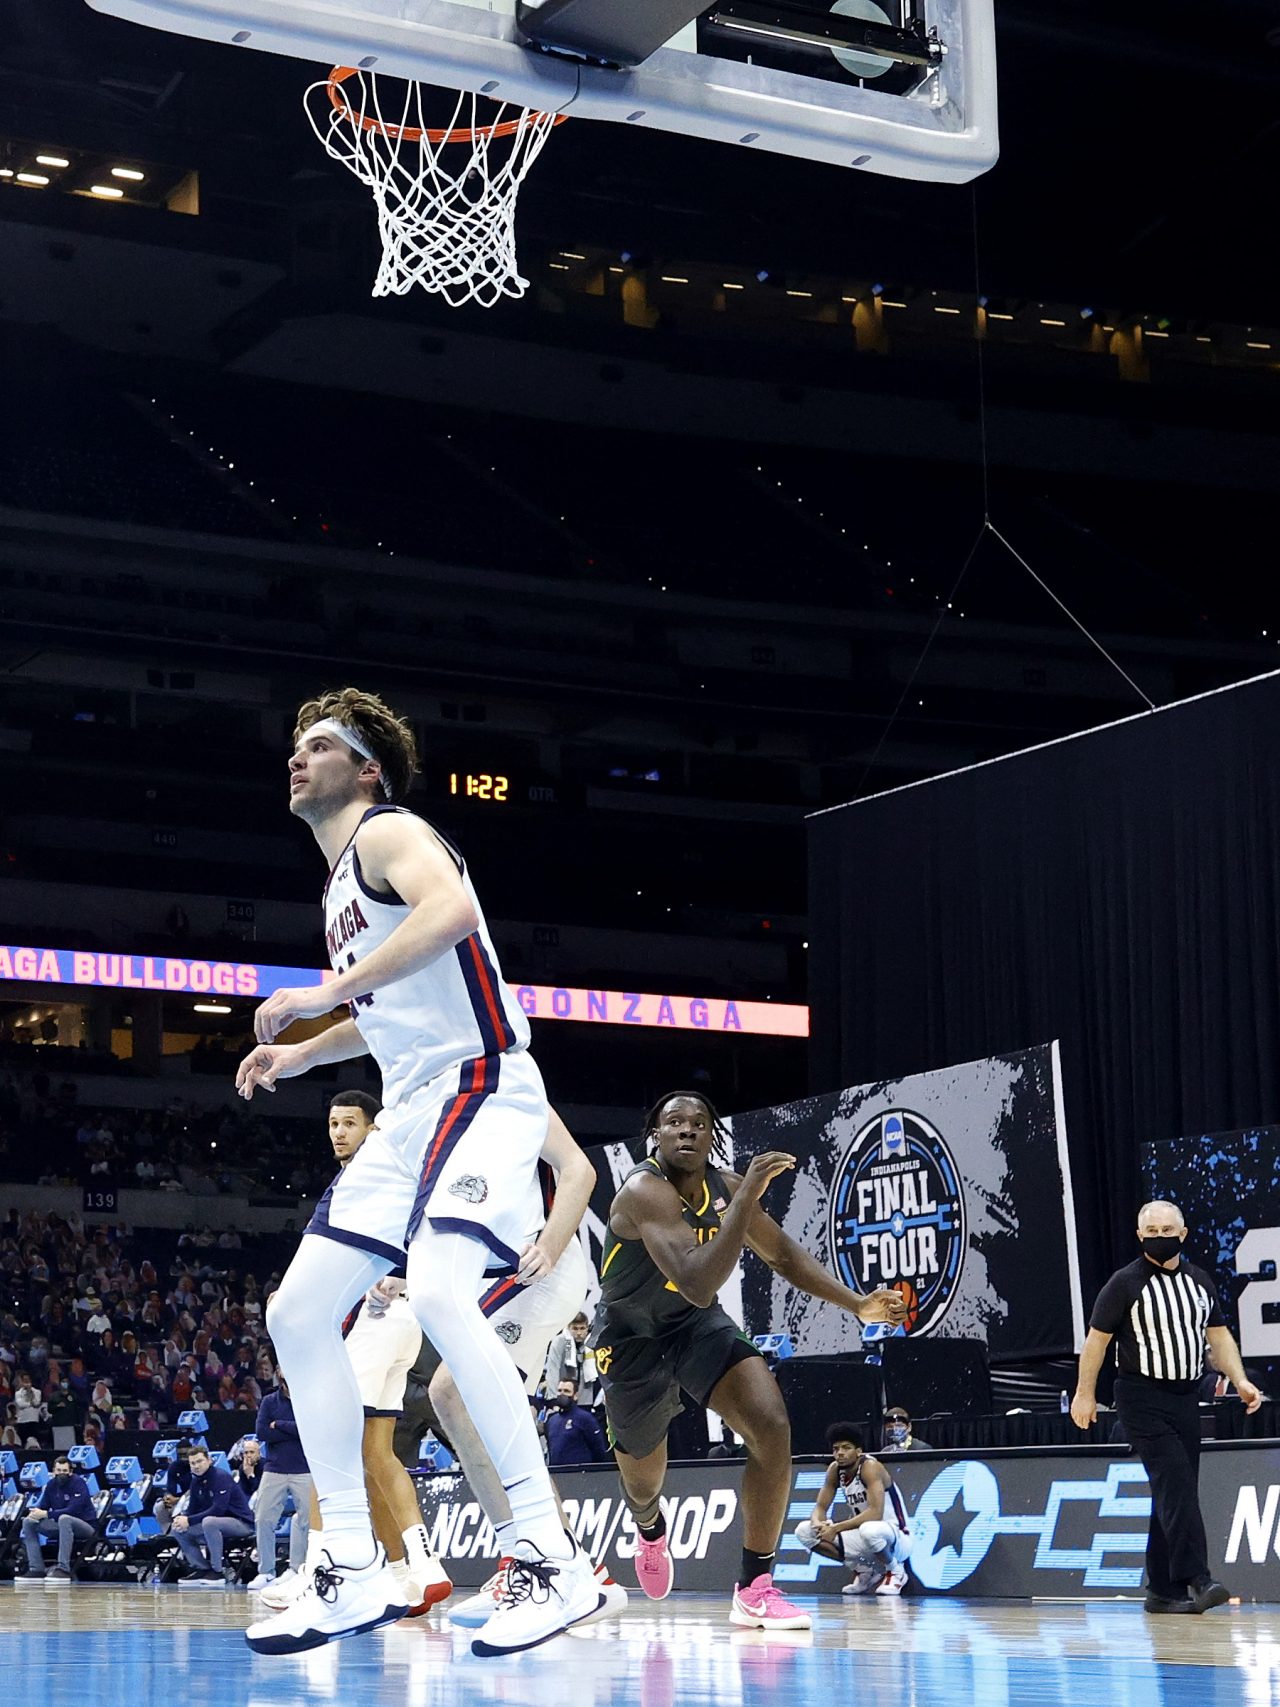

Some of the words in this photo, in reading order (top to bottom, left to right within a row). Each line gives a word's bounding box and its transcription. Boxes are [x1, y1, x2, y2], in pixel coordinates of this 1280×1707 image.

[450, 772, 508, 801] 11:22
[229, 905, 253, 919] 340
[72, 952, 260, 998] BULLDOGS
[516, 984, 742, 1031] GONZAGA
[871, 1159, 920, 1176] INDIANAPOLIS
[86, 1192, 114, 1208] 139
[856, 1170, 937, 1224] FINAL
[860, 1226, 939, 1282] FOUR
[916, 1278, 926, 1289] 21
